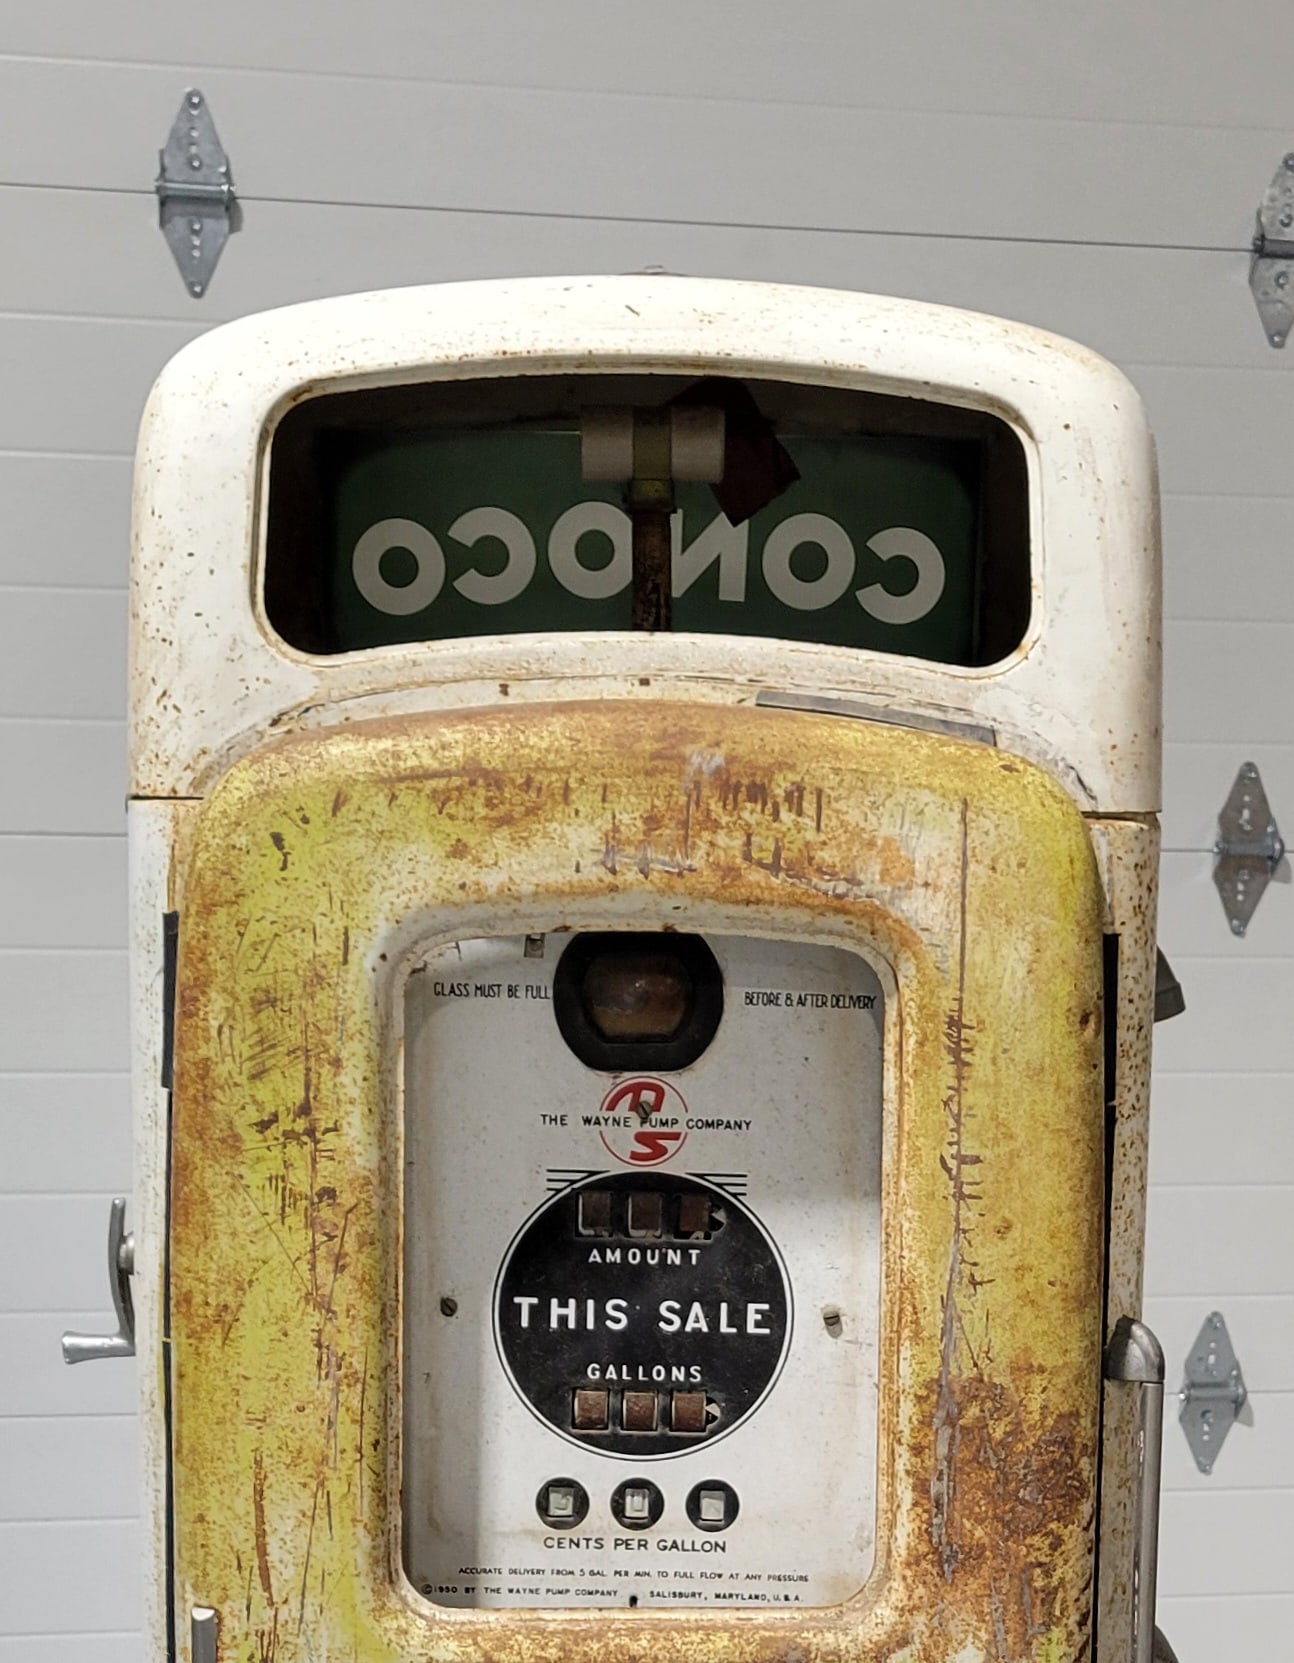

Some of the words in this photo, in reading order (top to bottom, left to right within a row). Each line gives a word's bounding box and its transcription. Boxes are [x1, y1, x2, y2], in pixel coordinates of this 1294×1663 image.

[433, 982, 469, 997] GLASS
[474, 984, 502, 998] MUST
[507, 984, 520, 998] BE
[525, 985, 550, 999] FULL
[744, 991, 782, 1007] BEFORE
[785, 993, 793, 1007] &
[797, 993, 828, 1008] AFTER
[830, 994, 877, 1009] DELIVERY
[540, 1113, 568, 1126] THE
[582, 1116, 632, 1128] WAYNE
[640, 1117, 679, 1129] PUMP
[686, 1118, 752, 1131] COMPANY
[588, 1247, 701, 1267] AMOUNT
[513, 1296, 629, 1331] THIS
[658, 1301, 771, 1335] SALE
[586, 1363, 702, 1383] GALLONS
[543, 1536, 605, 1550] CENTS
[614, 1538, 649, 1551] PER
[656, 1539, 726, 1554] GALLON
[458, 1567, 502, 1575] ACCURATE
[508, 1568, 546, 1576] DELIVERY
[551, 1568, 575, 1577] FROM
[613, 1570, 629, 1578] PER
[657, 1570, 669, 1579] TO
[673, 1570, 695, 1579] FULL
[699, 1571, 723, 1580] FLOW
[728, 1573, 739, 1581] AT
[744, 1573, 762, 1582] ANY
[767, 1574, 809, 1583] PRESSURE
[464, 1586, 476, 1594] BY
[484, 1586, 502, 1595] THE
[507, 1588, 541, 1596] WAYNE
[545, 1588, 571, 1597] PUMP
[575, 1588, 618, 1598] COMPANY
